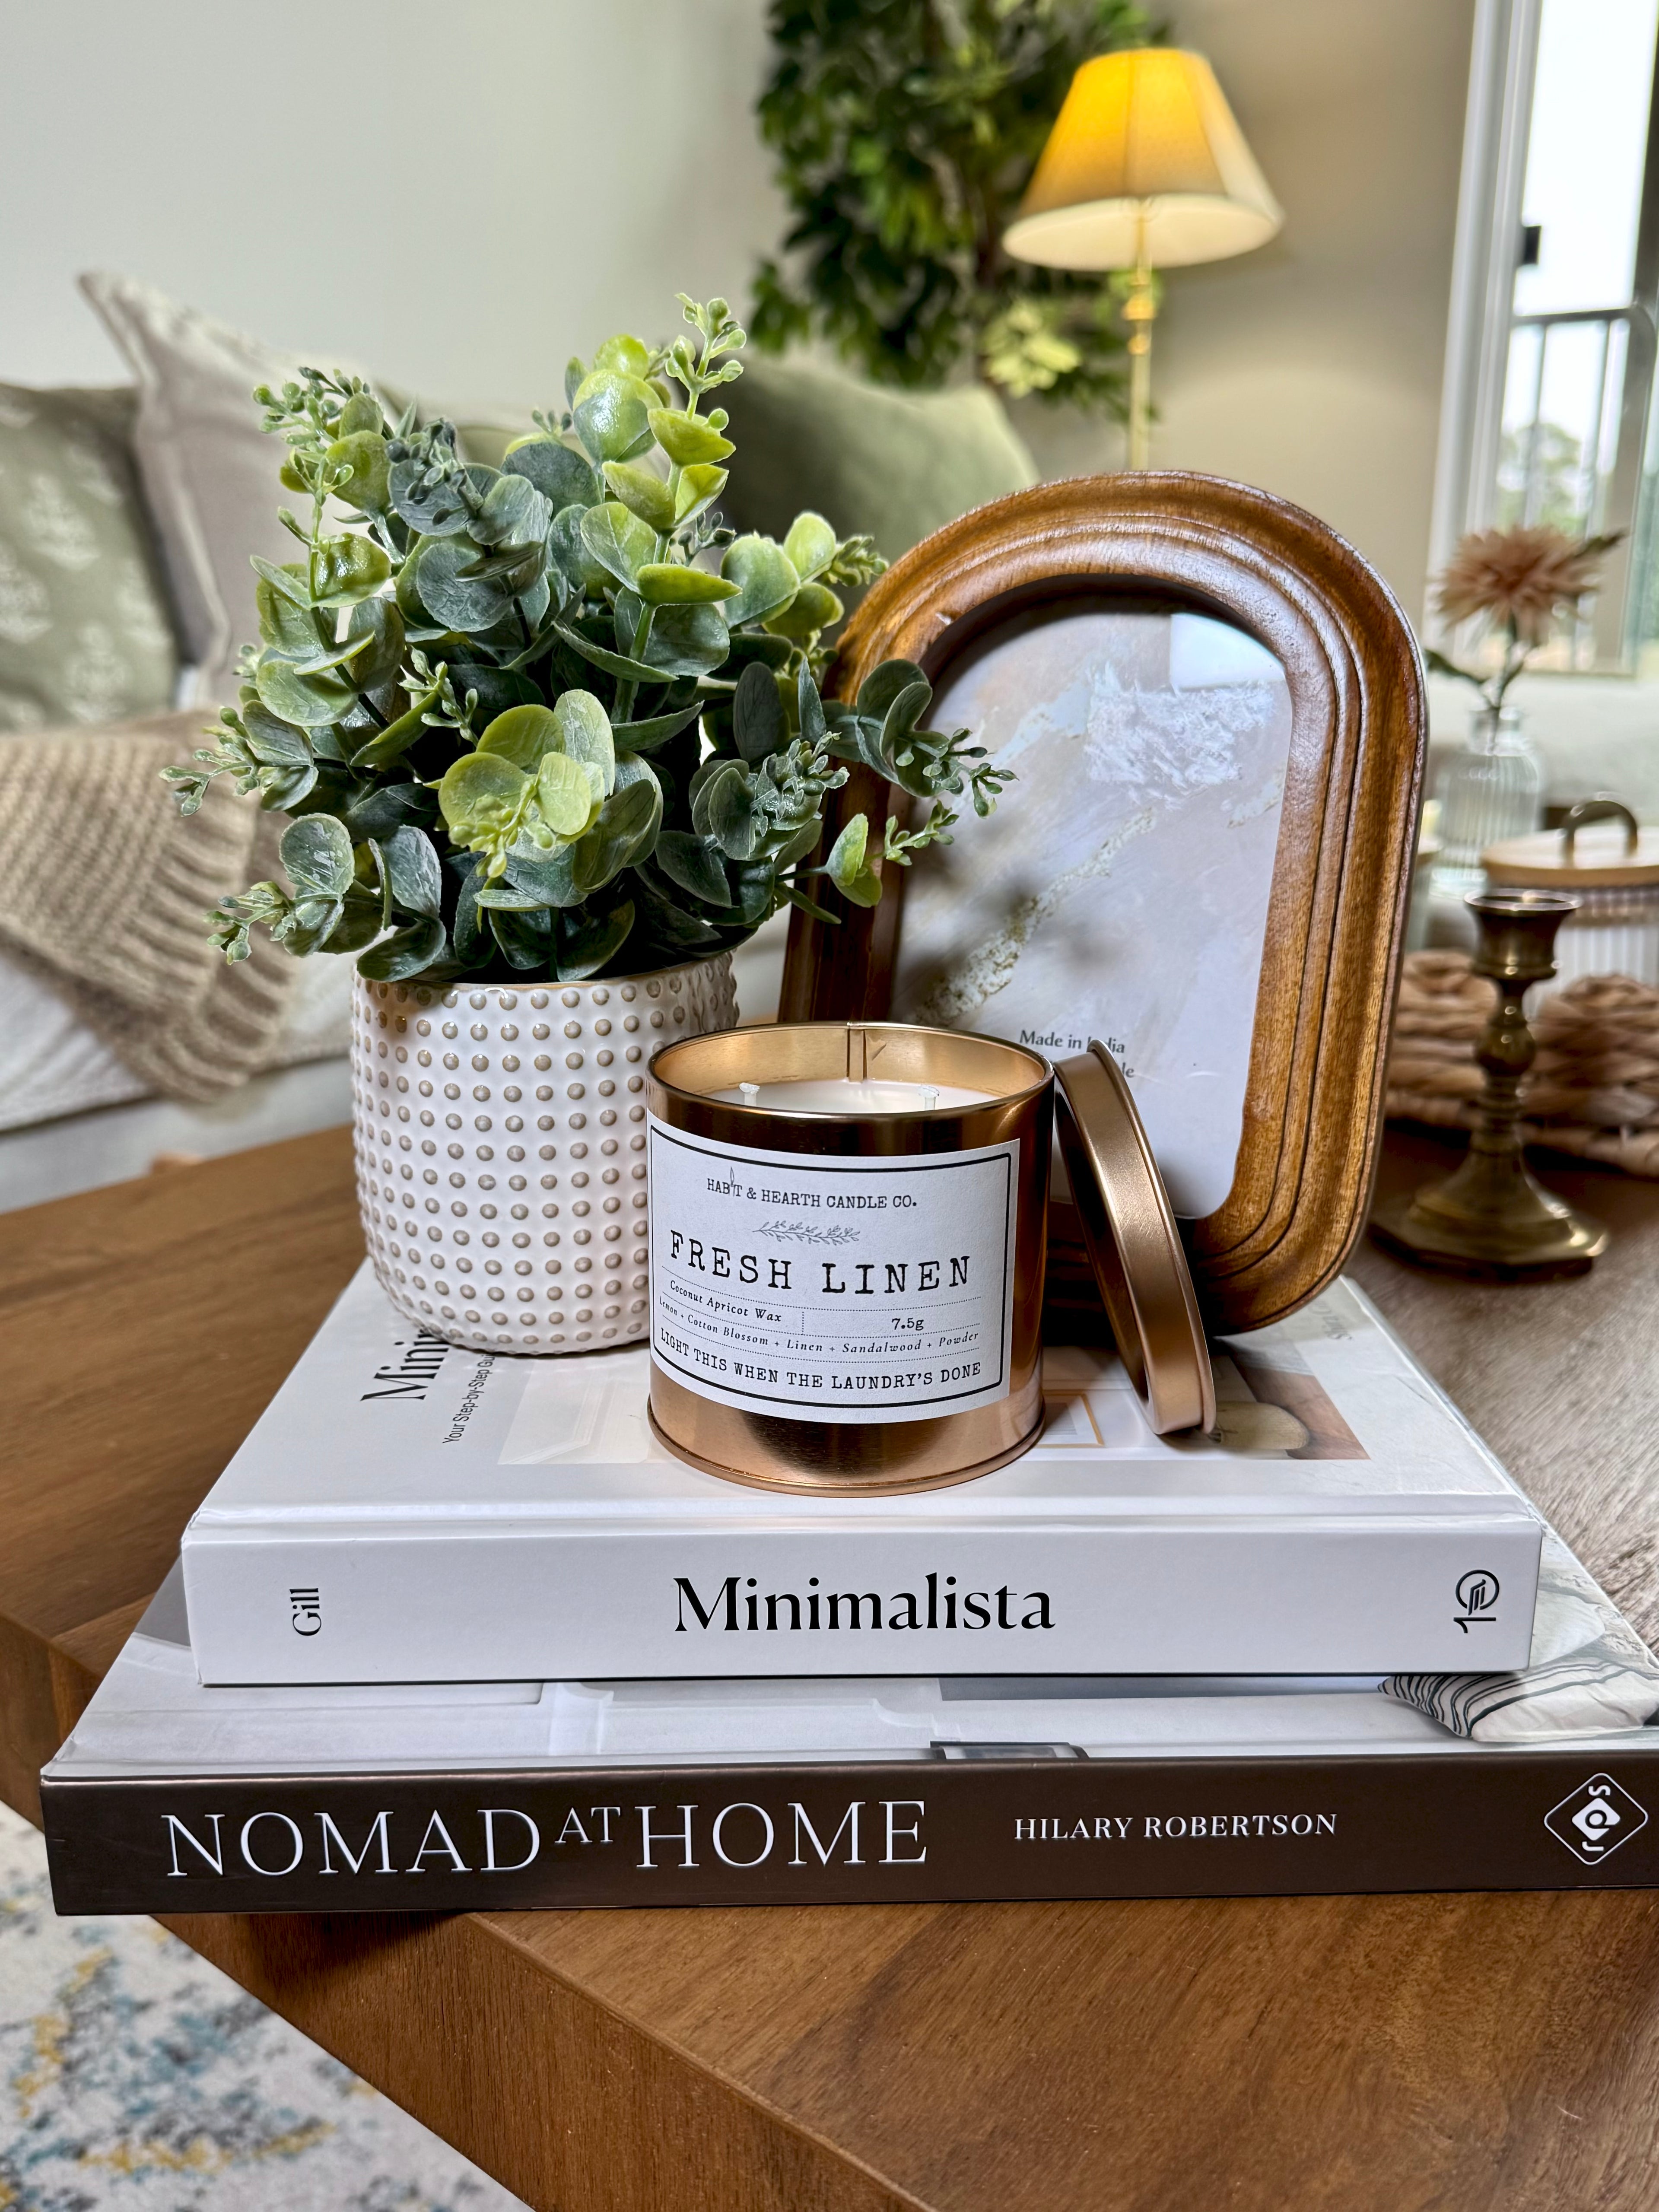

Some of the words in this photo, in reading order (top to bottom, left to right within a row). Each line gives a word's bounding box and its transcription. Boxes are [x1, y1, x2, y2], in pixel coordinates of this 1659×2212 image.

[1019, 1030, 1063, 1047] Made
[1068, 1034, 1082, 1049] in
[747, 1187, 756, 1200] &
[761, 1189, 821, 1208] HEARTH
[826, 1195, 887, 1209] CANDLE
[893, 1195, 917, 1208] CO.
[671, 1229, 792, 1290] FRESH
[822, 1255, 970, 1294] LINEN
[659, 1295, 677, 1316] Lemon
[688, 1314, 719, 1333] Cotton
[723, 1326, 769, 1346] Blossom
[787, 1339, 822, 1351] Linen
[842, 1339, 922, 1353] Sandalwood
[939, 1331, 979, 1347] Powder
[670, 1280, 703, 1303] Coconut
[706, 1297, 749, 1316] Apricot
[755, 1308, 782, 1322] Wax
[891, 1317, 924, 1331] 7.5g
[661, 1327, 689, 1356] LIGHT
[693, 1348, 727, 1371] THIS
[733, 1362, 779, 1383] WHEN
[786, 1372, 823, 1388] THE
[941, 1362, 981, 1383] DONE
[452, 1369, 493, 1422] Step-by-Step
[442, 1423, 466, 1443] Your
[289, 1588, 322, 1636] Gill
[673, 1572, 1056, 1631] Minimalista
[161, 1809, 540, 1876] NOMAD
[555, 1807, 621, 1843] AT
[635, 1801, 926, 1867] HOME
[1014, 1818, 1133, 1839] HILARY
[1144, 1814, 1337, 1837] ROBERTSON
